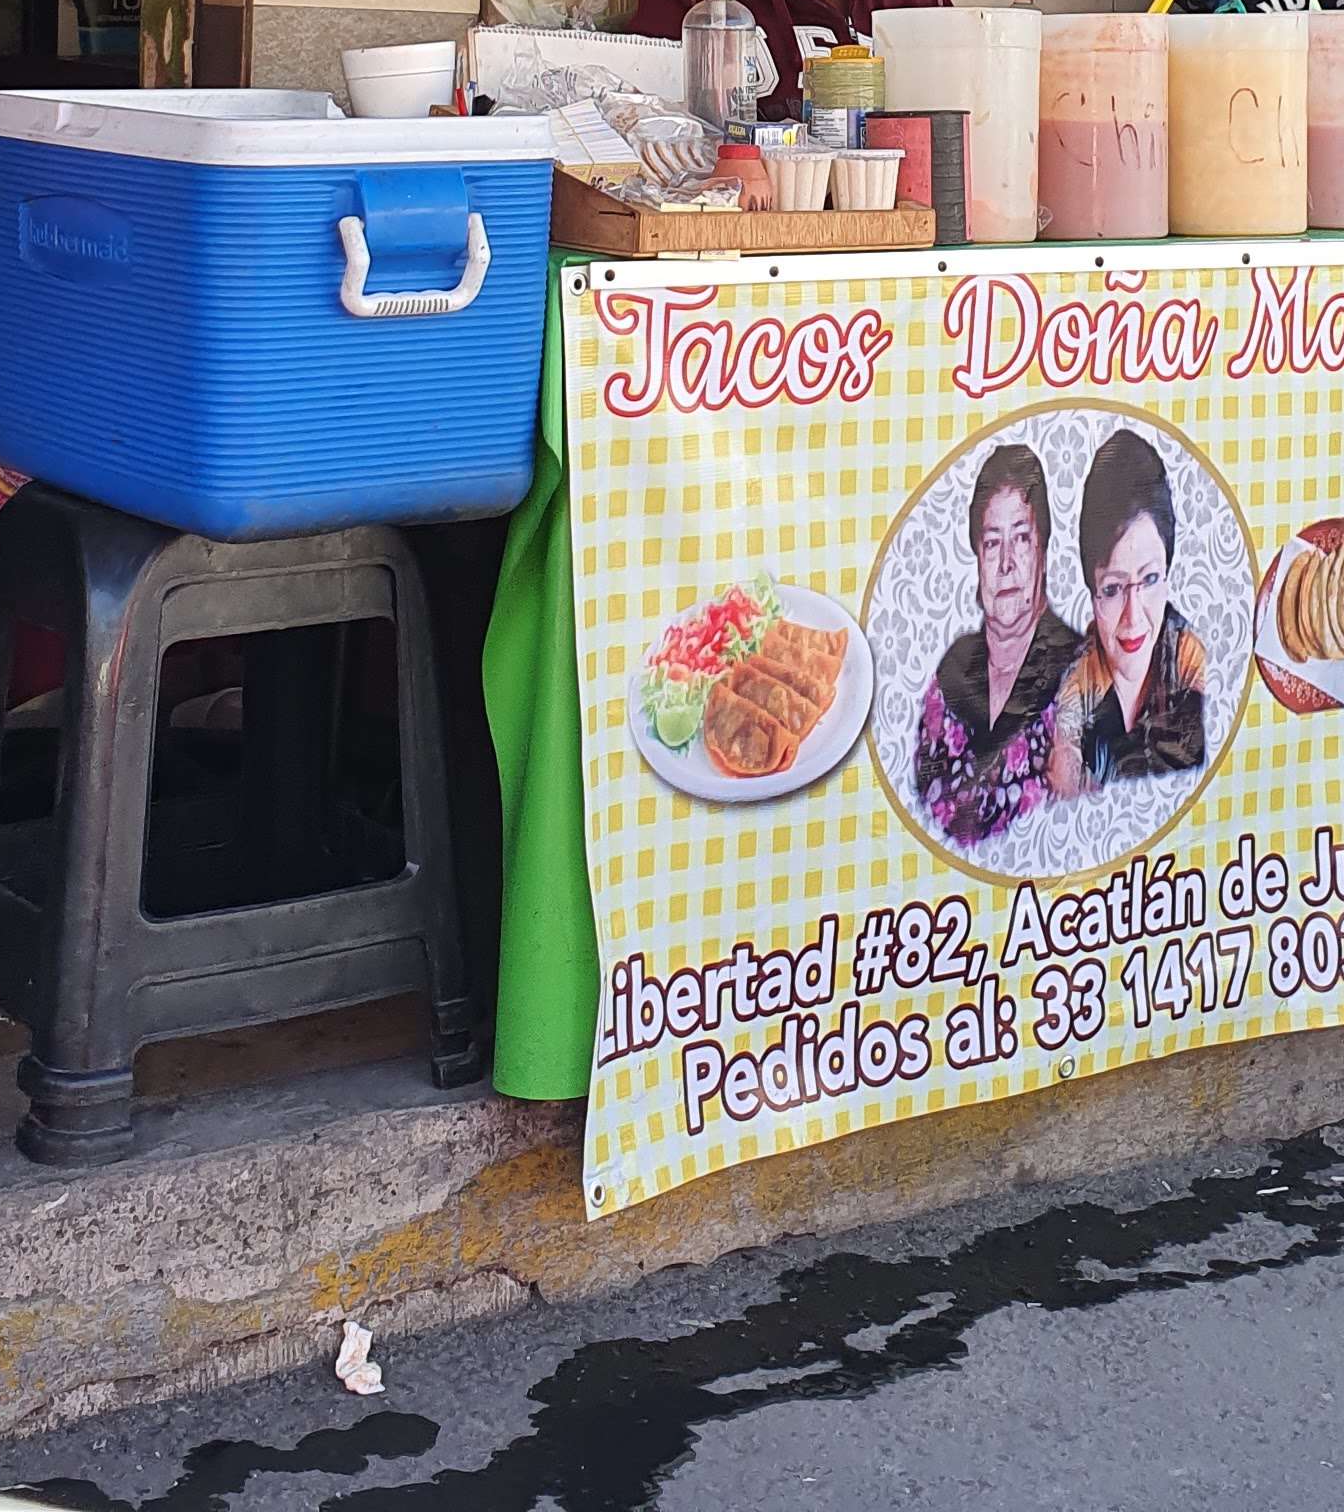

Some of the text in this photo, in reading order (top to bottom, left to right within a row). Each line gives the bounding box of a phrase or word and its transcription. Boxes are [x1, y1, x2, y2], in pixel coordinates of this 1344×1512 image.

[594, 283, 894, 419] Tacos
[944, 270, 1218, 399] Doña
[597, 913, 837, 1068] Libertad
[854, 895, 987, 993] #82,
[1000, 852, 1206, 968] Acatlán
[1220, 832, 1288, 920] de
[682, 1003, 932, 1136] Pedidos
[945, 972, 1019, 1069] al:
[1032, 955, 1108, 1052] 33
[1120, 924, 1255, 1029] 1417
